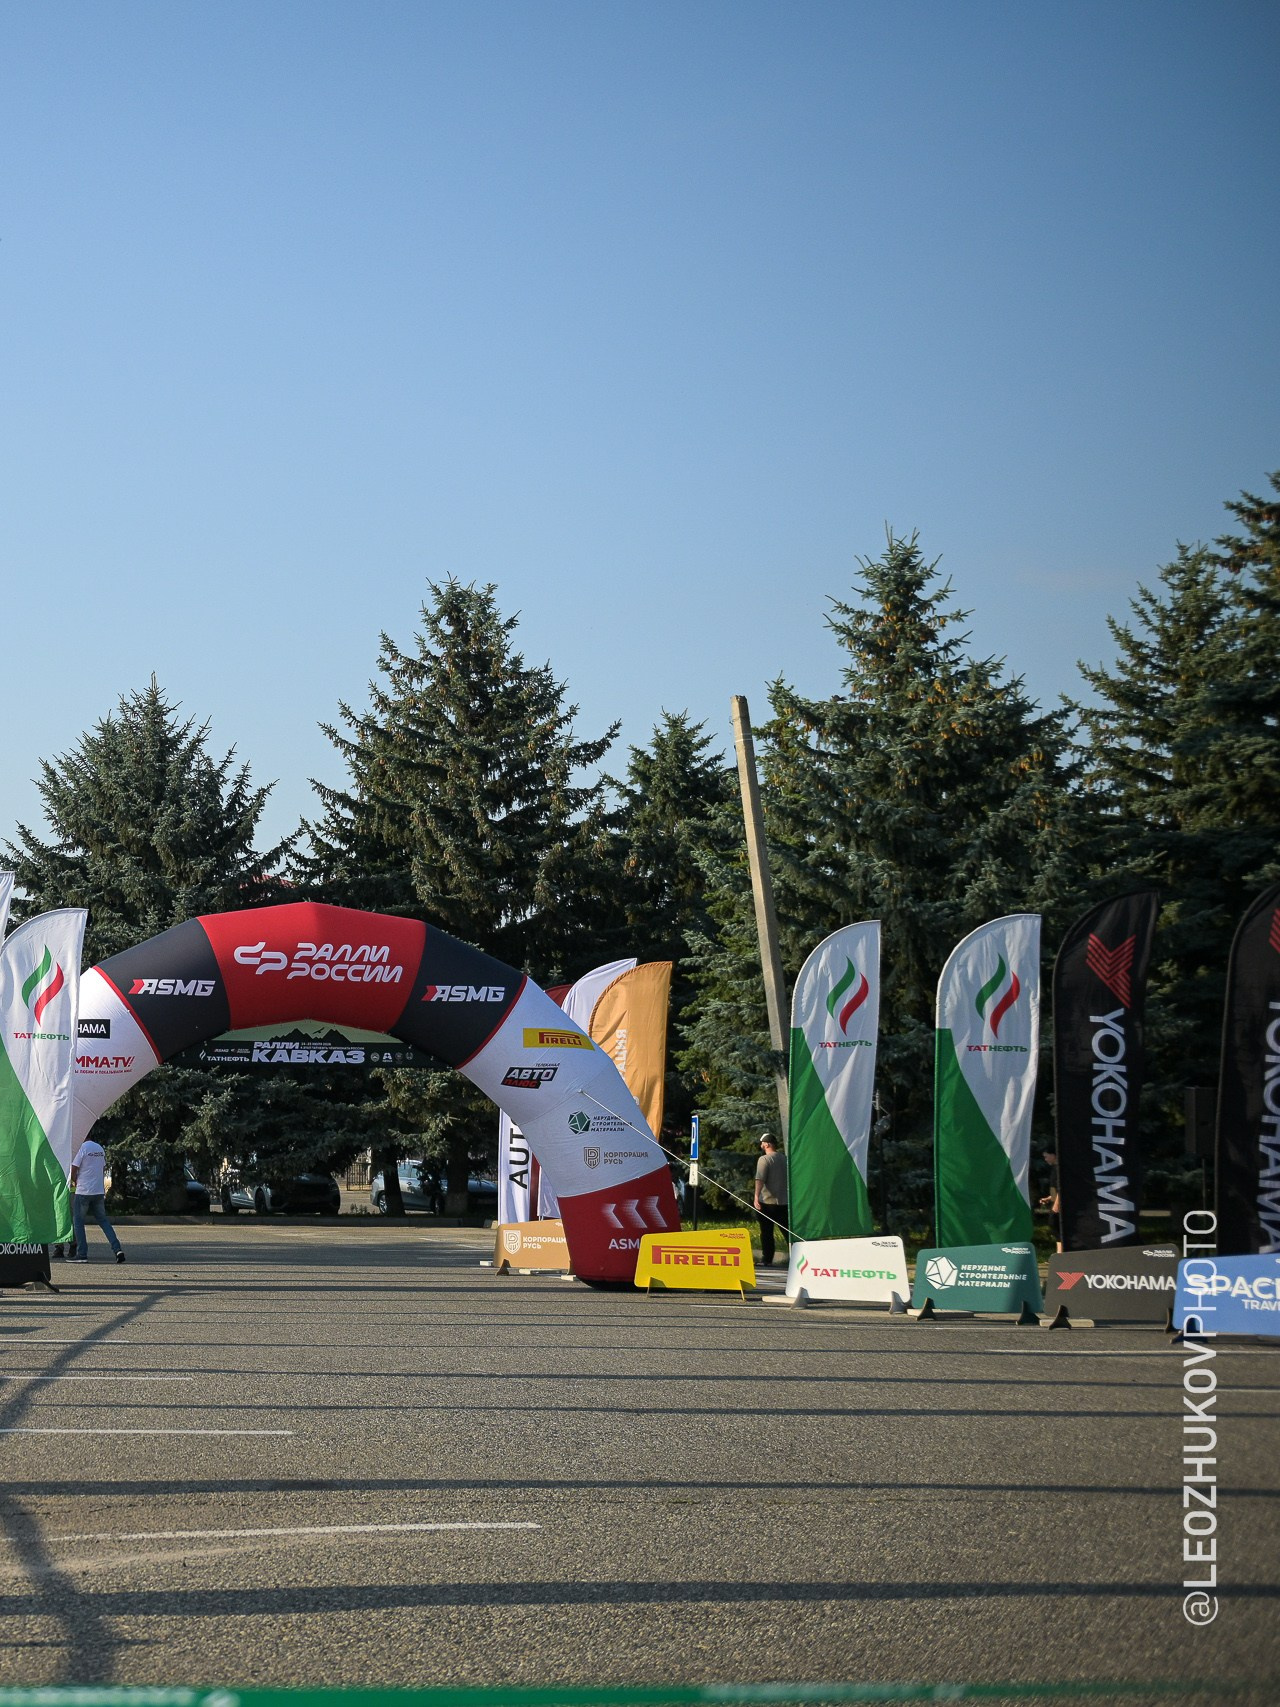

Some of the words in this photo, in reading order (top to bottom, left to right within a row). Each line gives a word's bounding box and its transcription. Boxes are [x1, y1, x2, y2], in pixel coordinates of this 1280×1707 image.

[294, 943, 390, 962] РАЛЛИ
[287, 962, 403, 983] РОССИИ
[135, 978, 216, 997] ASMG
[430, 985, 505, 1002] ASMG
[77, 1023, 107, 1034] HAMA
[13, 1032, 70, 1041] ТАТНЕФТЬ
[539, 1032, 583, 1046] PIRELLI
[253, 1041, 299, 1049] РАЛЛИ
[818, 1040, 873, 1048] ТАТНЕФТЬ
[966, 1044, 1028, 1053] ТАТНЕФТЬ
[252, 1050, 365, 1064] КАВКАЗ
[507, 1068, 555, 1080] АВТО
[503, 1079, 539, 1088] ПЛЮС
[1089, 1007, 1136, 1244] YOKOHAMA
[509, 1119, 530, 1190] AUT
[609, 1238, 641, 1250] ASM
[652, 1245, 741, 1267] PIRELLI
[811, 1268, 897, 1280] ТАТНЕФТЬ
[961, 1264, 1006, 1272] НЕРУДНЫЕ
[959, 1272, 1027, 1280] СТРОИТЕЛЬНЫЕ
[957, 1280, 1011, 1288] МАТЕРИАЛЫ
[1083, 1274, 1177, 1291] YOKOHAMA
